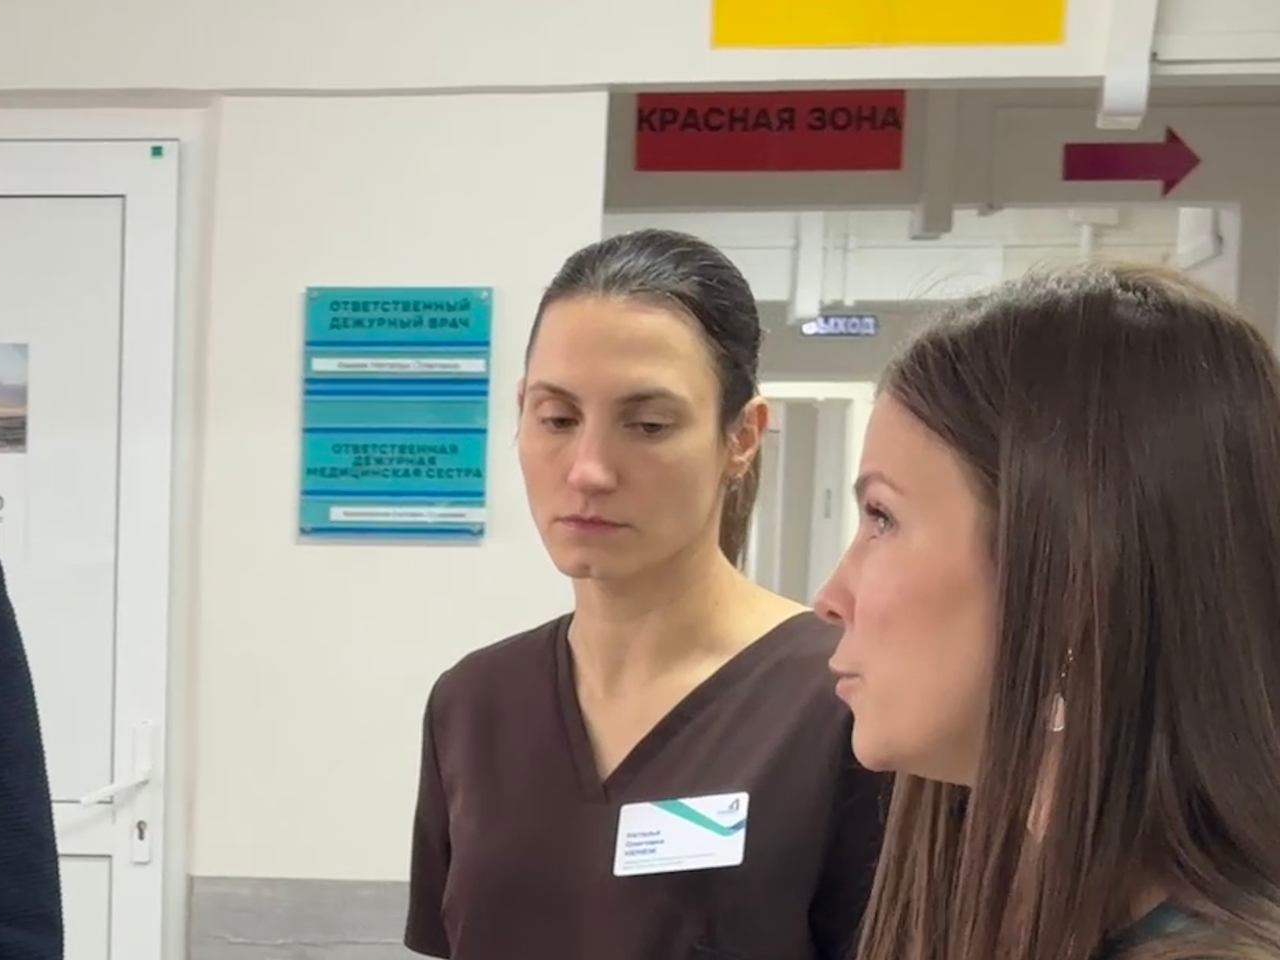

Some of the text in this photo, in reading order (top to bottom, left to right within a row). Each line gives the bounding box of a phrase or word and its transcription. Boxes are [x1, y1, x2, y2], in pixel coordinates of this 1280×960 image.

[637, 105, 902, 132] КРАСНАЯ ЗОНА
[329, 297, 471, 312] ОТВЕТСТВЕННЫЙ
[329, 316, 470, 331] ДЕЖУРНЫЙ ВРАЧ
[802, 317, 875, 334] ЫХОД
[331, 443, 459, 455] ОТВЕТСТВЕННАЯ
[352, 456, 437, 467] ДЕЖУРНАЯ
[306, 467, 483, 480] МЕДИЦИНСКАЯ СЕСТРА
